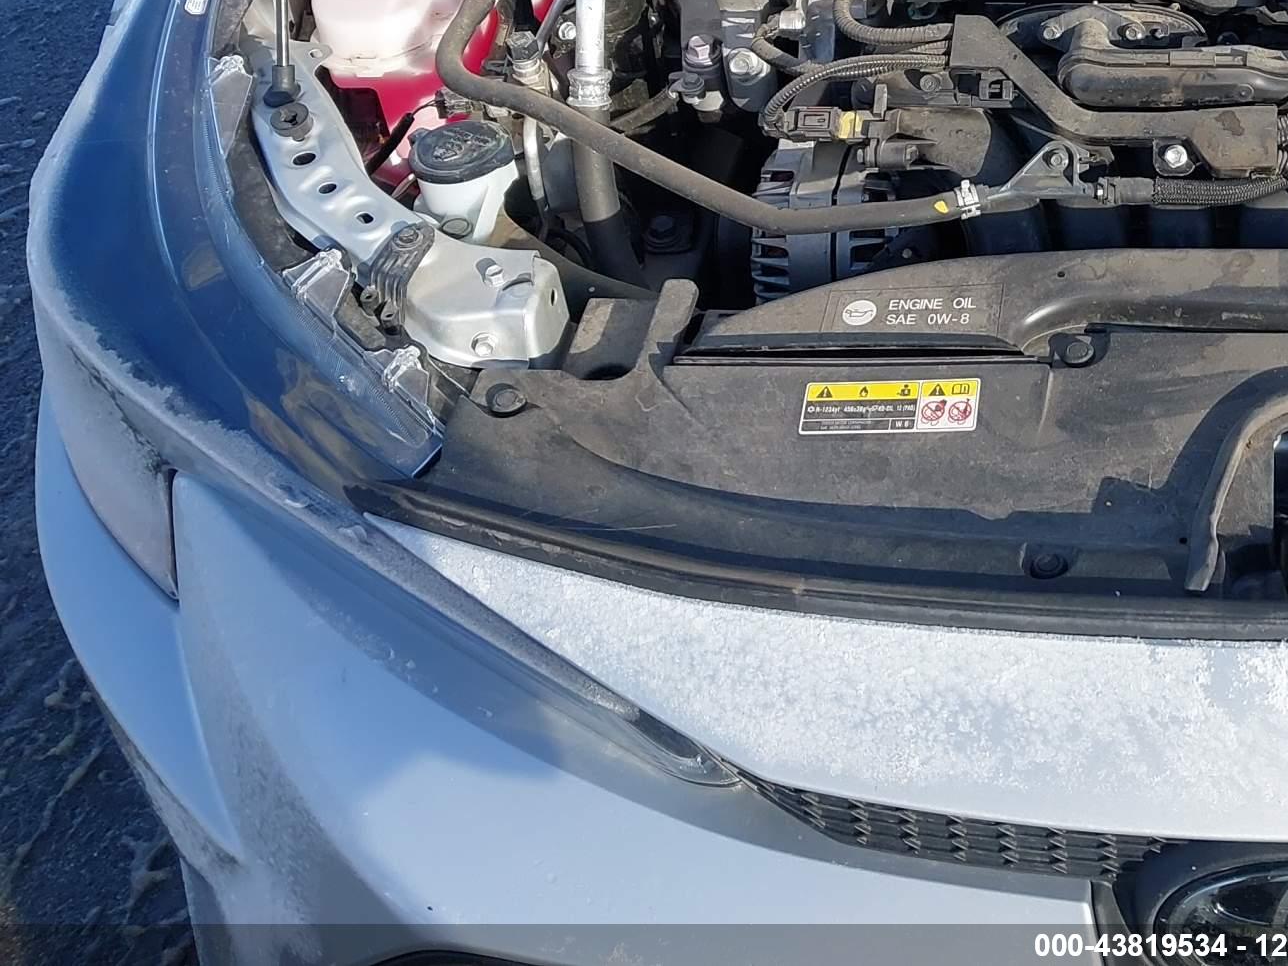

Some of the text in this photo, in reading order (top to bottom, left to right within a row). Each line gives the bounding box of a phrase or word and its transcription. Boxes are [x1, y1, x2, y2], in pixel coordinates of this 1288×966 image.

[888, 297, 977, 310] ENGINE OIL
[886, 313, 970, 325] SAE 0W-8
